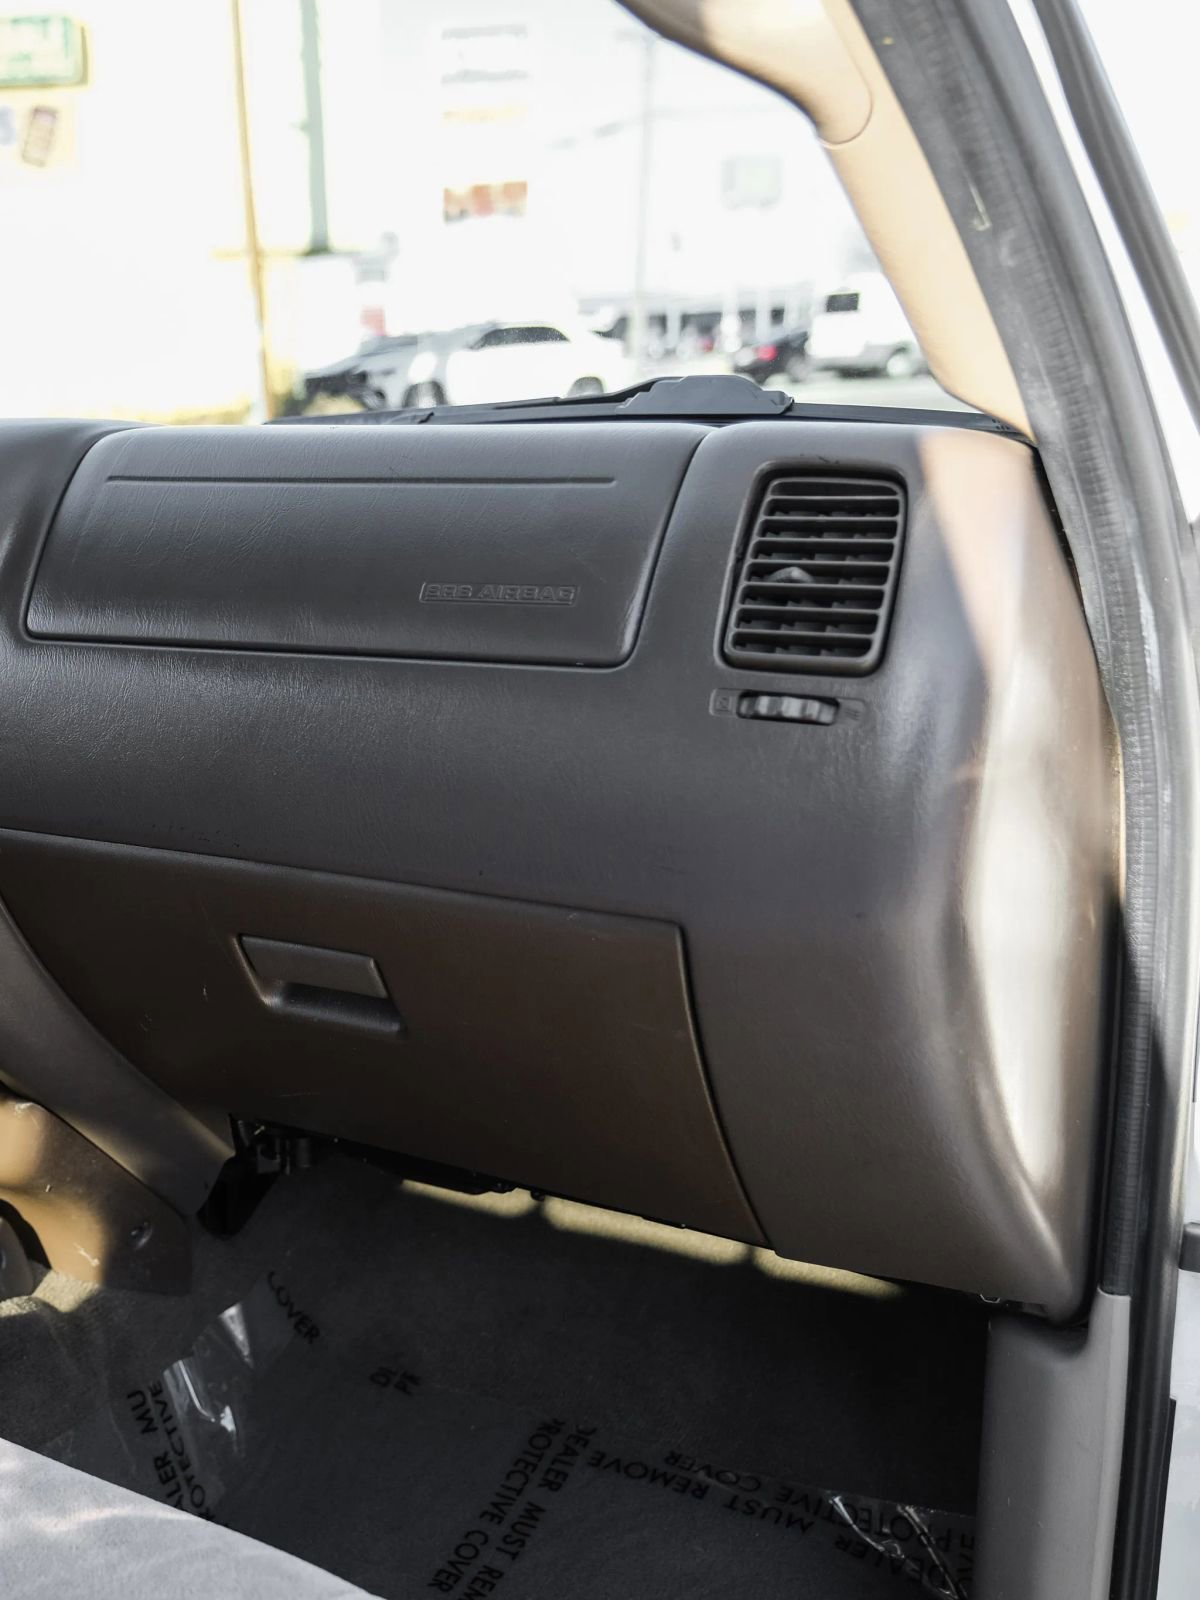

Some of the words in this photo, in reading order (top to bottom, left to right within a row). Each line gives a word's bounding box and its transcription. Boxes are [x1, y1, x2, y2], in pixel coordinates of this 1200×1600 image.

[478, 584, 576, 602] AIRBAG
[266, 1270, 321, 1344] COVER
[588, 1450, 710, 1500] REMOVE
[664, 1449, 761, 1494] COVER
[496, 1502, 546, 1561] MUST
[724, 1494, 815, 1534] MUST
[427, 1530, 489, 1592] COVER
